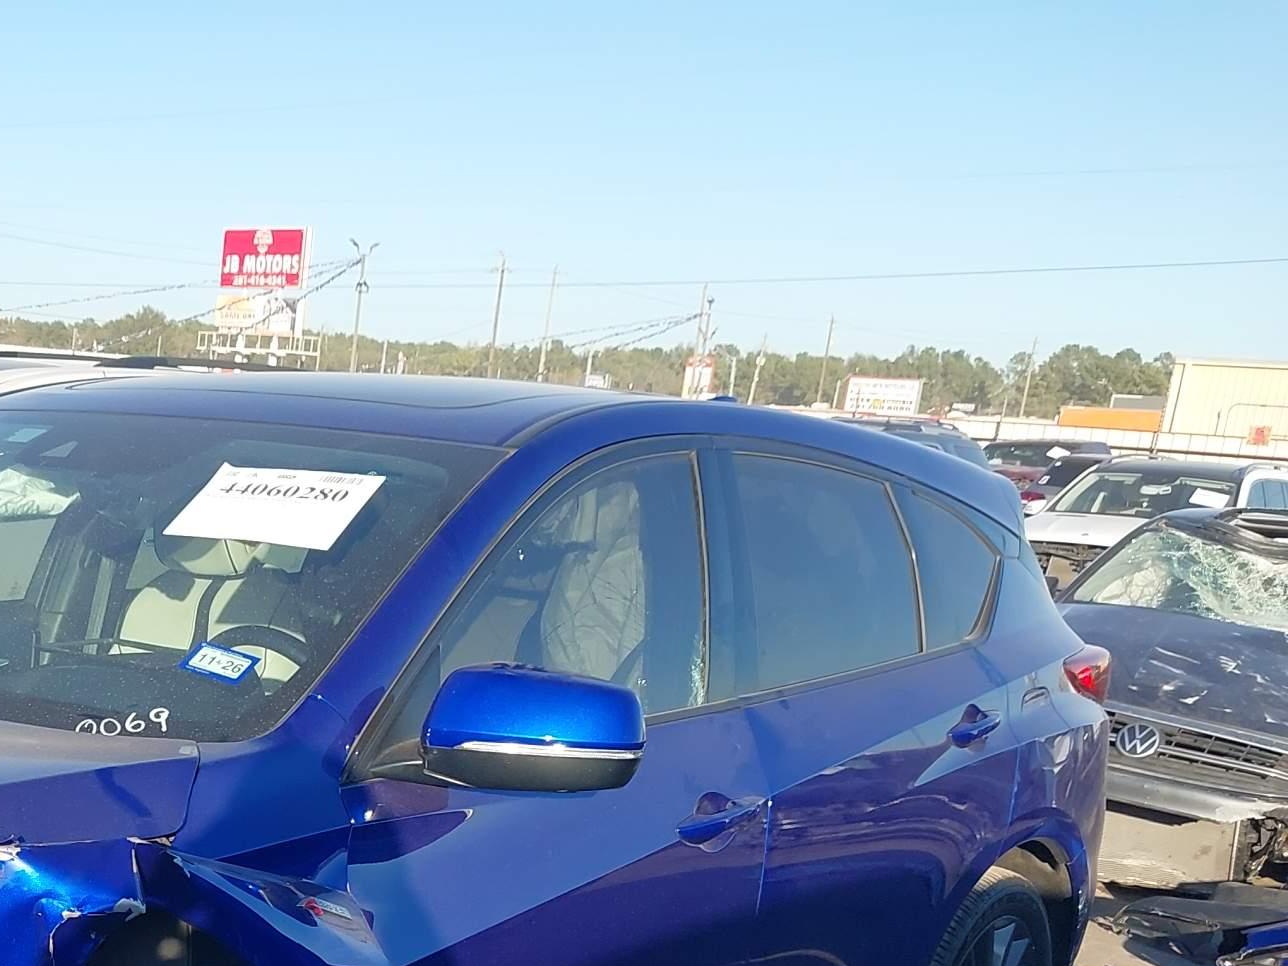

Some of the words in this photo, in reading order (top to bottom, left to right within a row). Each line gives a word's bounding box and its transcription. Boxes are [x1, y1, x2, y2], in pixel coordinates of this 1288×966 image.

[242, 254, 300, 274] MOTORS
[220, 481, 349, 502] 44060280
[221, 660, 244, 674] 26
